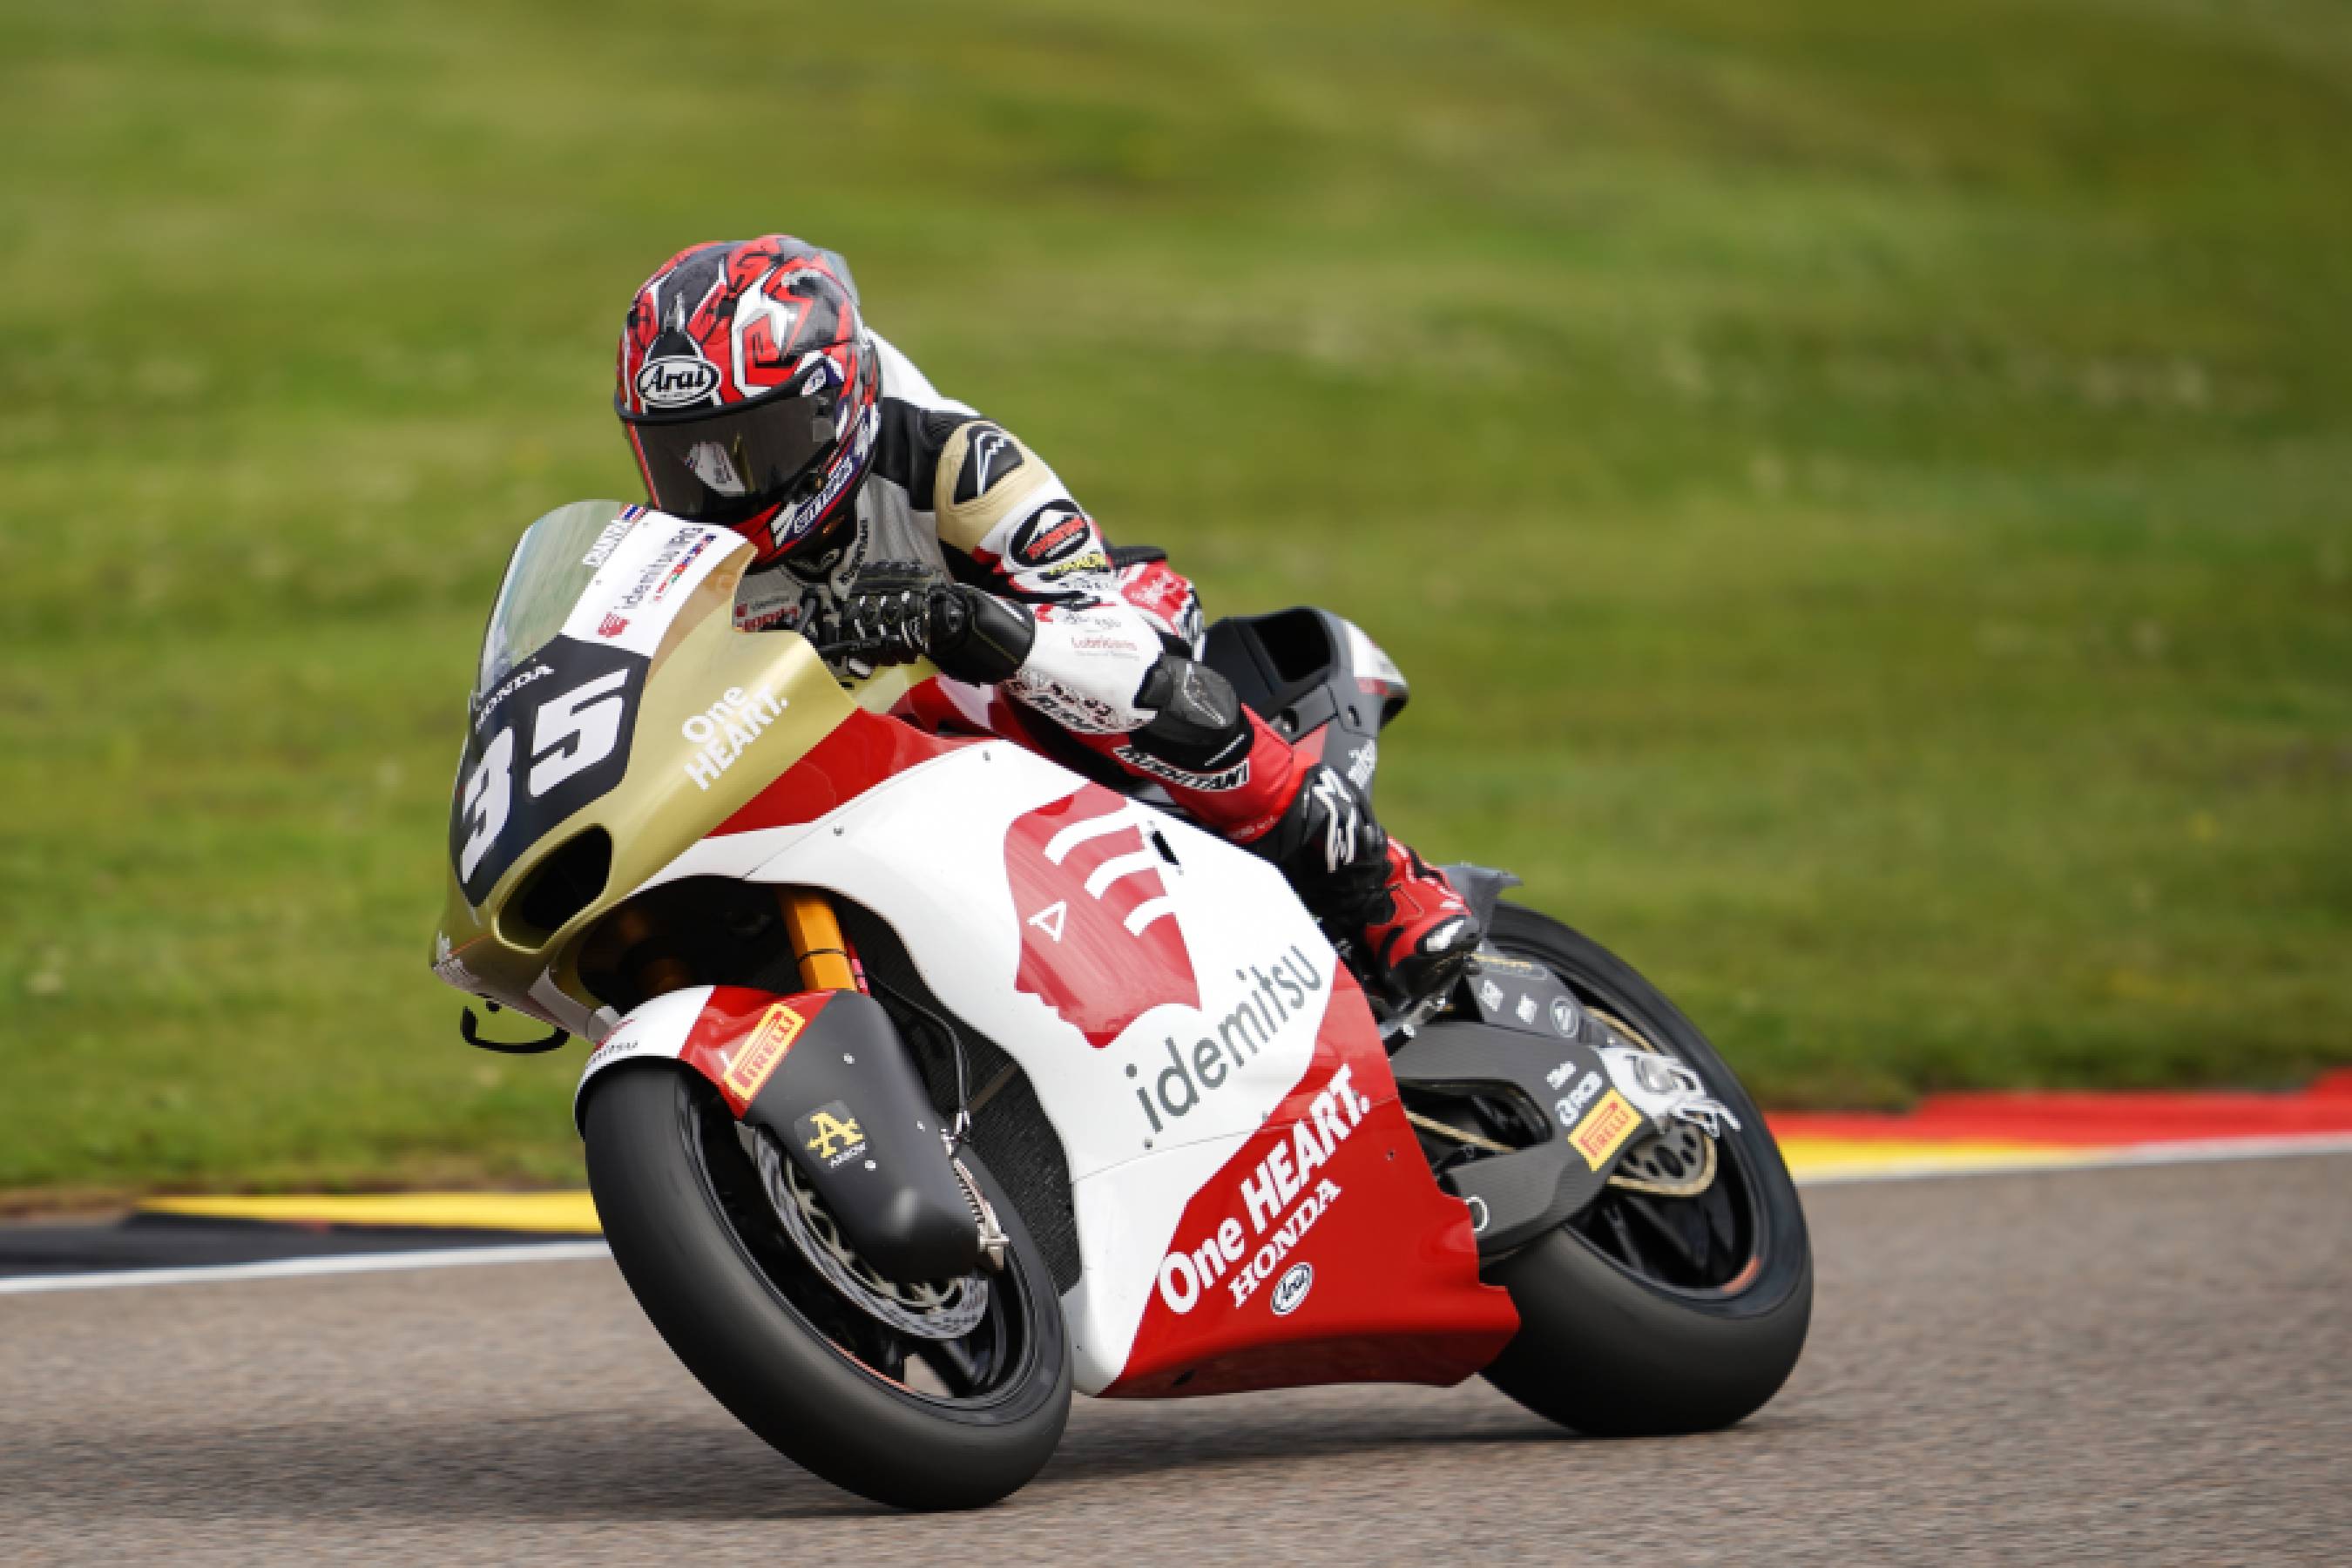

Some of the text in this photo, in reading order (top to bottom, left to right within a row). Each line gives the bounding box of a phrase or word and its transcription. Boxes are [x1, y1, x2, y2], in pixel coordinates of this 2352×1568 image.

[647, 366, 705, 391] Arai
[683, 686, 746, 743] One
[683, 685, 790, 791] HEART.
[460, 669, 630, 884] 35
[732, 1010, 795, 1088] PIRELLI
[1125, 943, 1323, 1133] idemitsu
[1578, 1100, 1631, 1158] PIRELLI
[1159, 1063, 1371, 1315] One HEART.
[1227, 1177, 1343, 1308] HONDA
